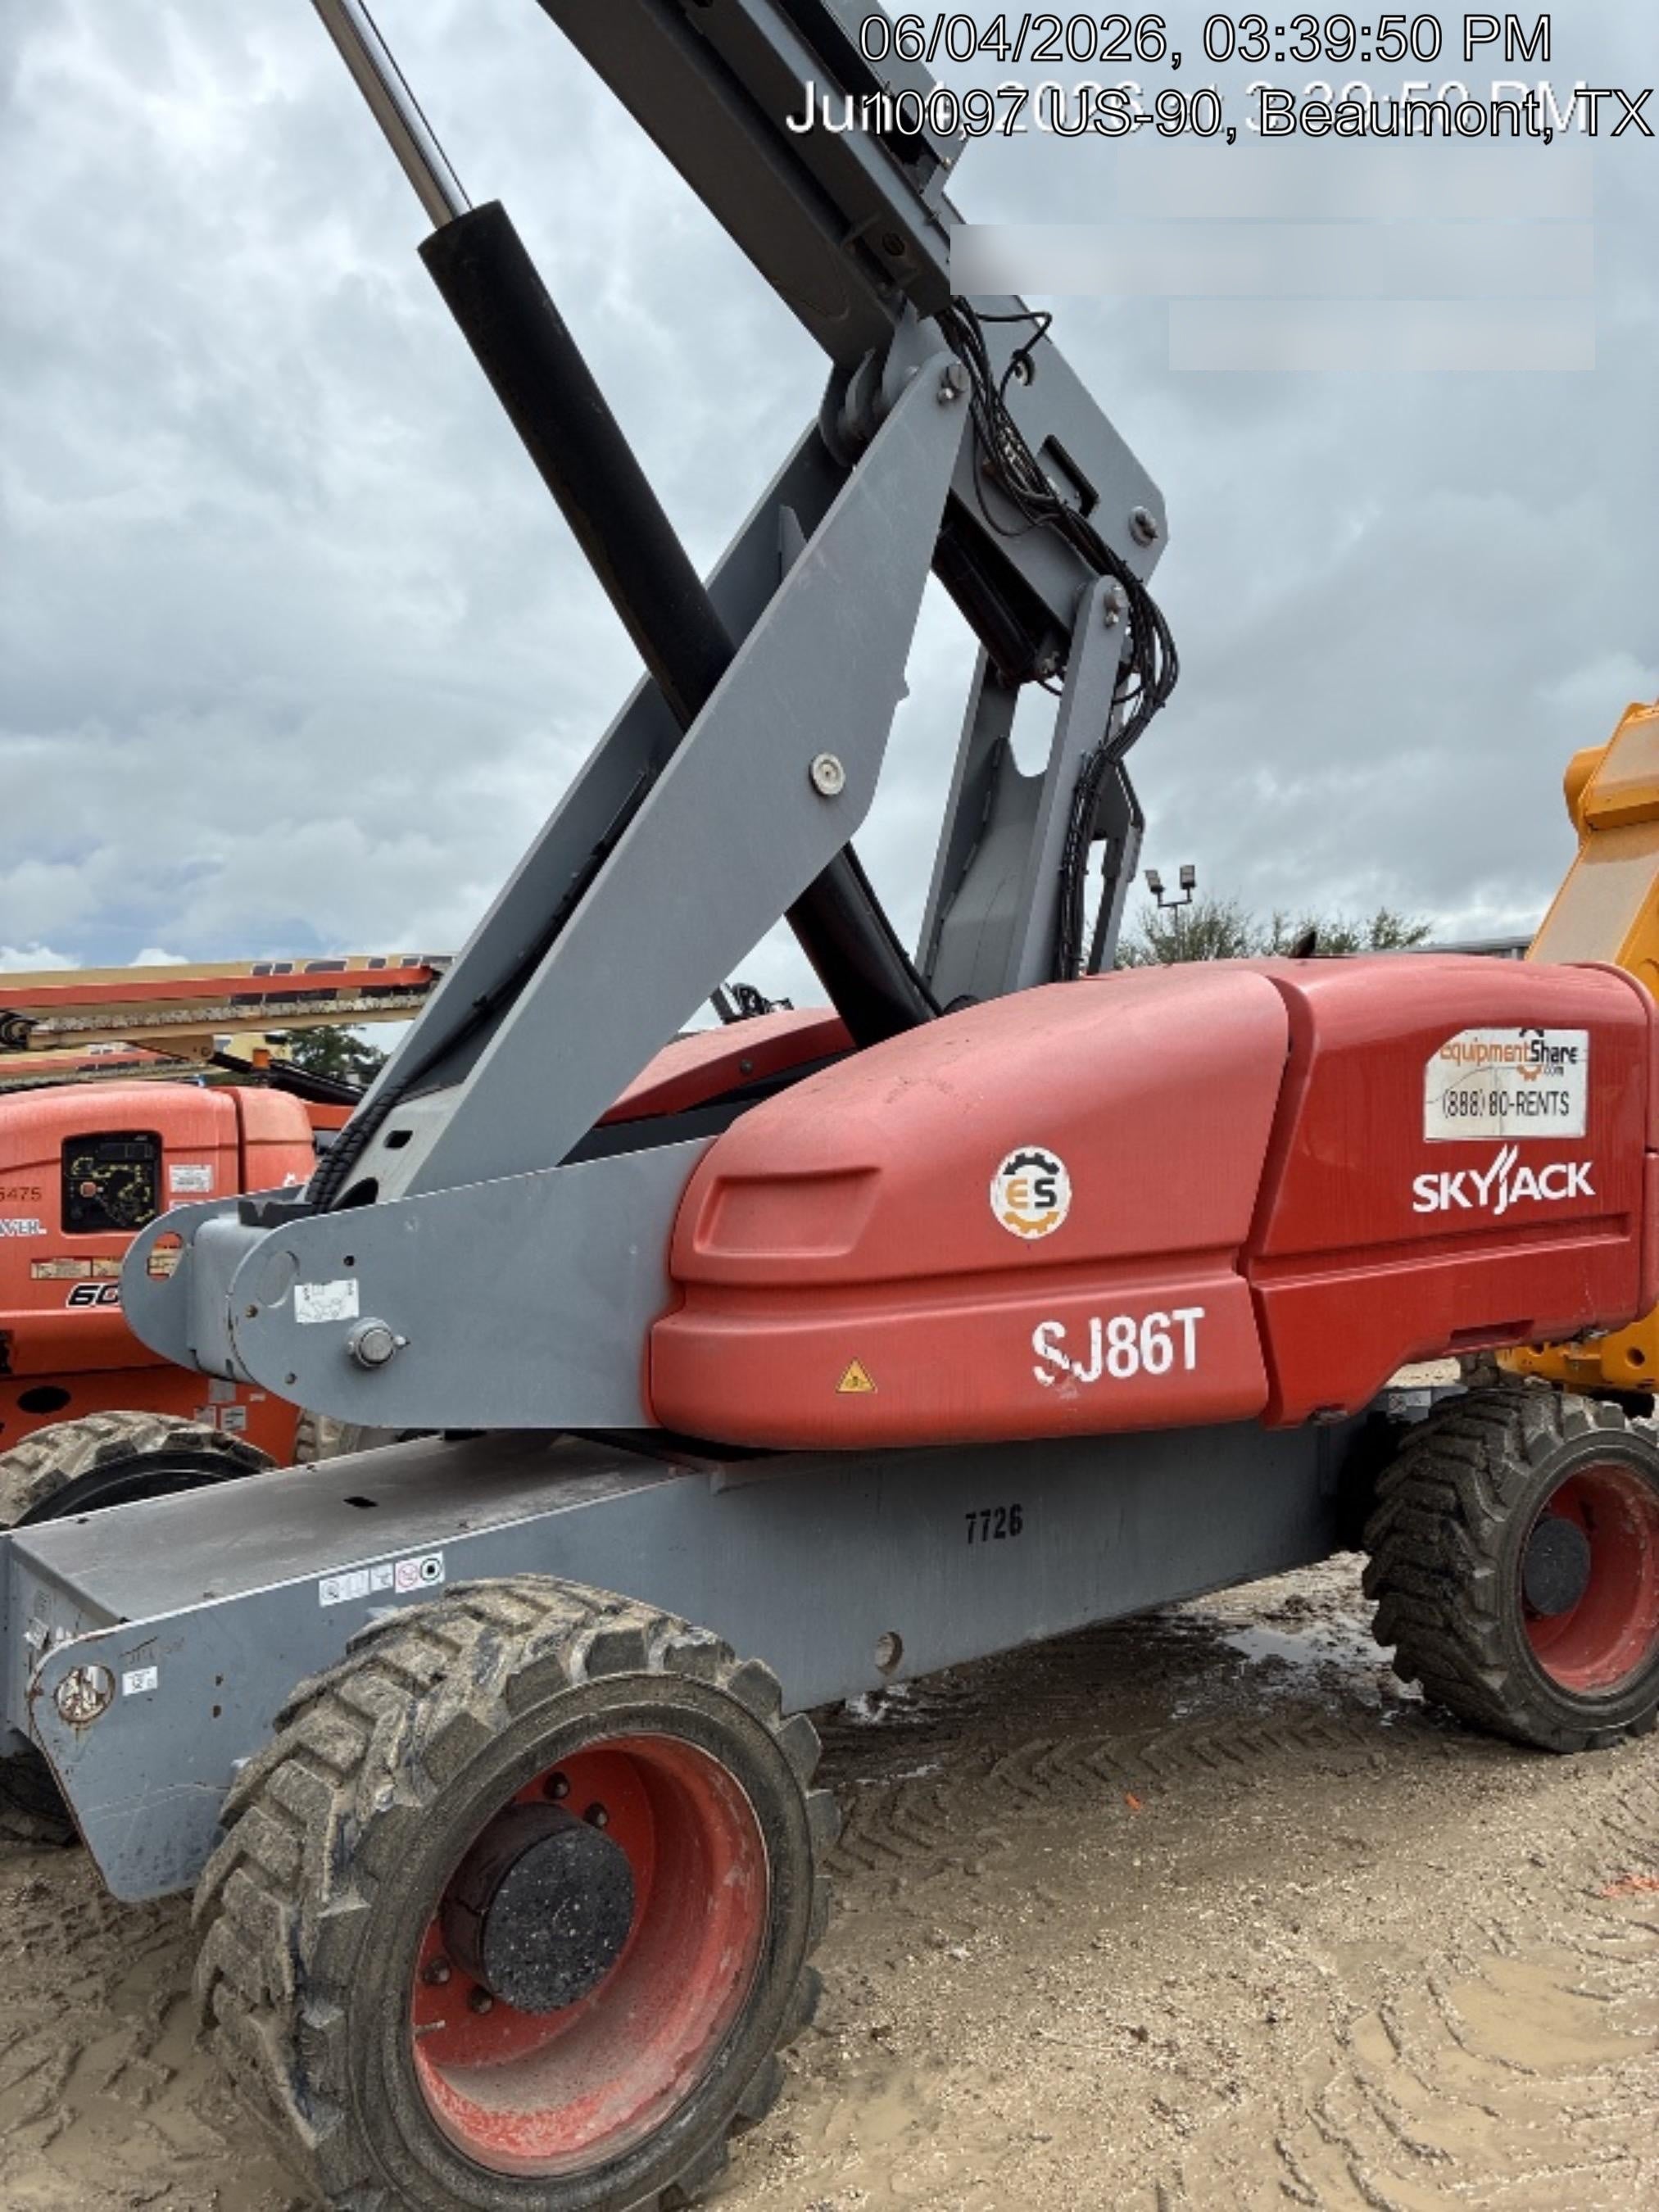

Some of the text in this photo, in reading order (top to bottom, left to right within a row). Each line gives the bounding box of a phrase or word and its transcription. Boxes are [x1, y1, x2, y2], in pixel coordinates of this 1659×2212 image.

[1442, 1088, 1570, 1118] (888) 80-RENTS
[1005, 1177, 1058, 1209] ES
[1412, 1142, 1596, 1216] SKYJACK
[1031, 1307, 1205, 1387] SJ86T
[965, 1503, 1023, 1544] 7726
